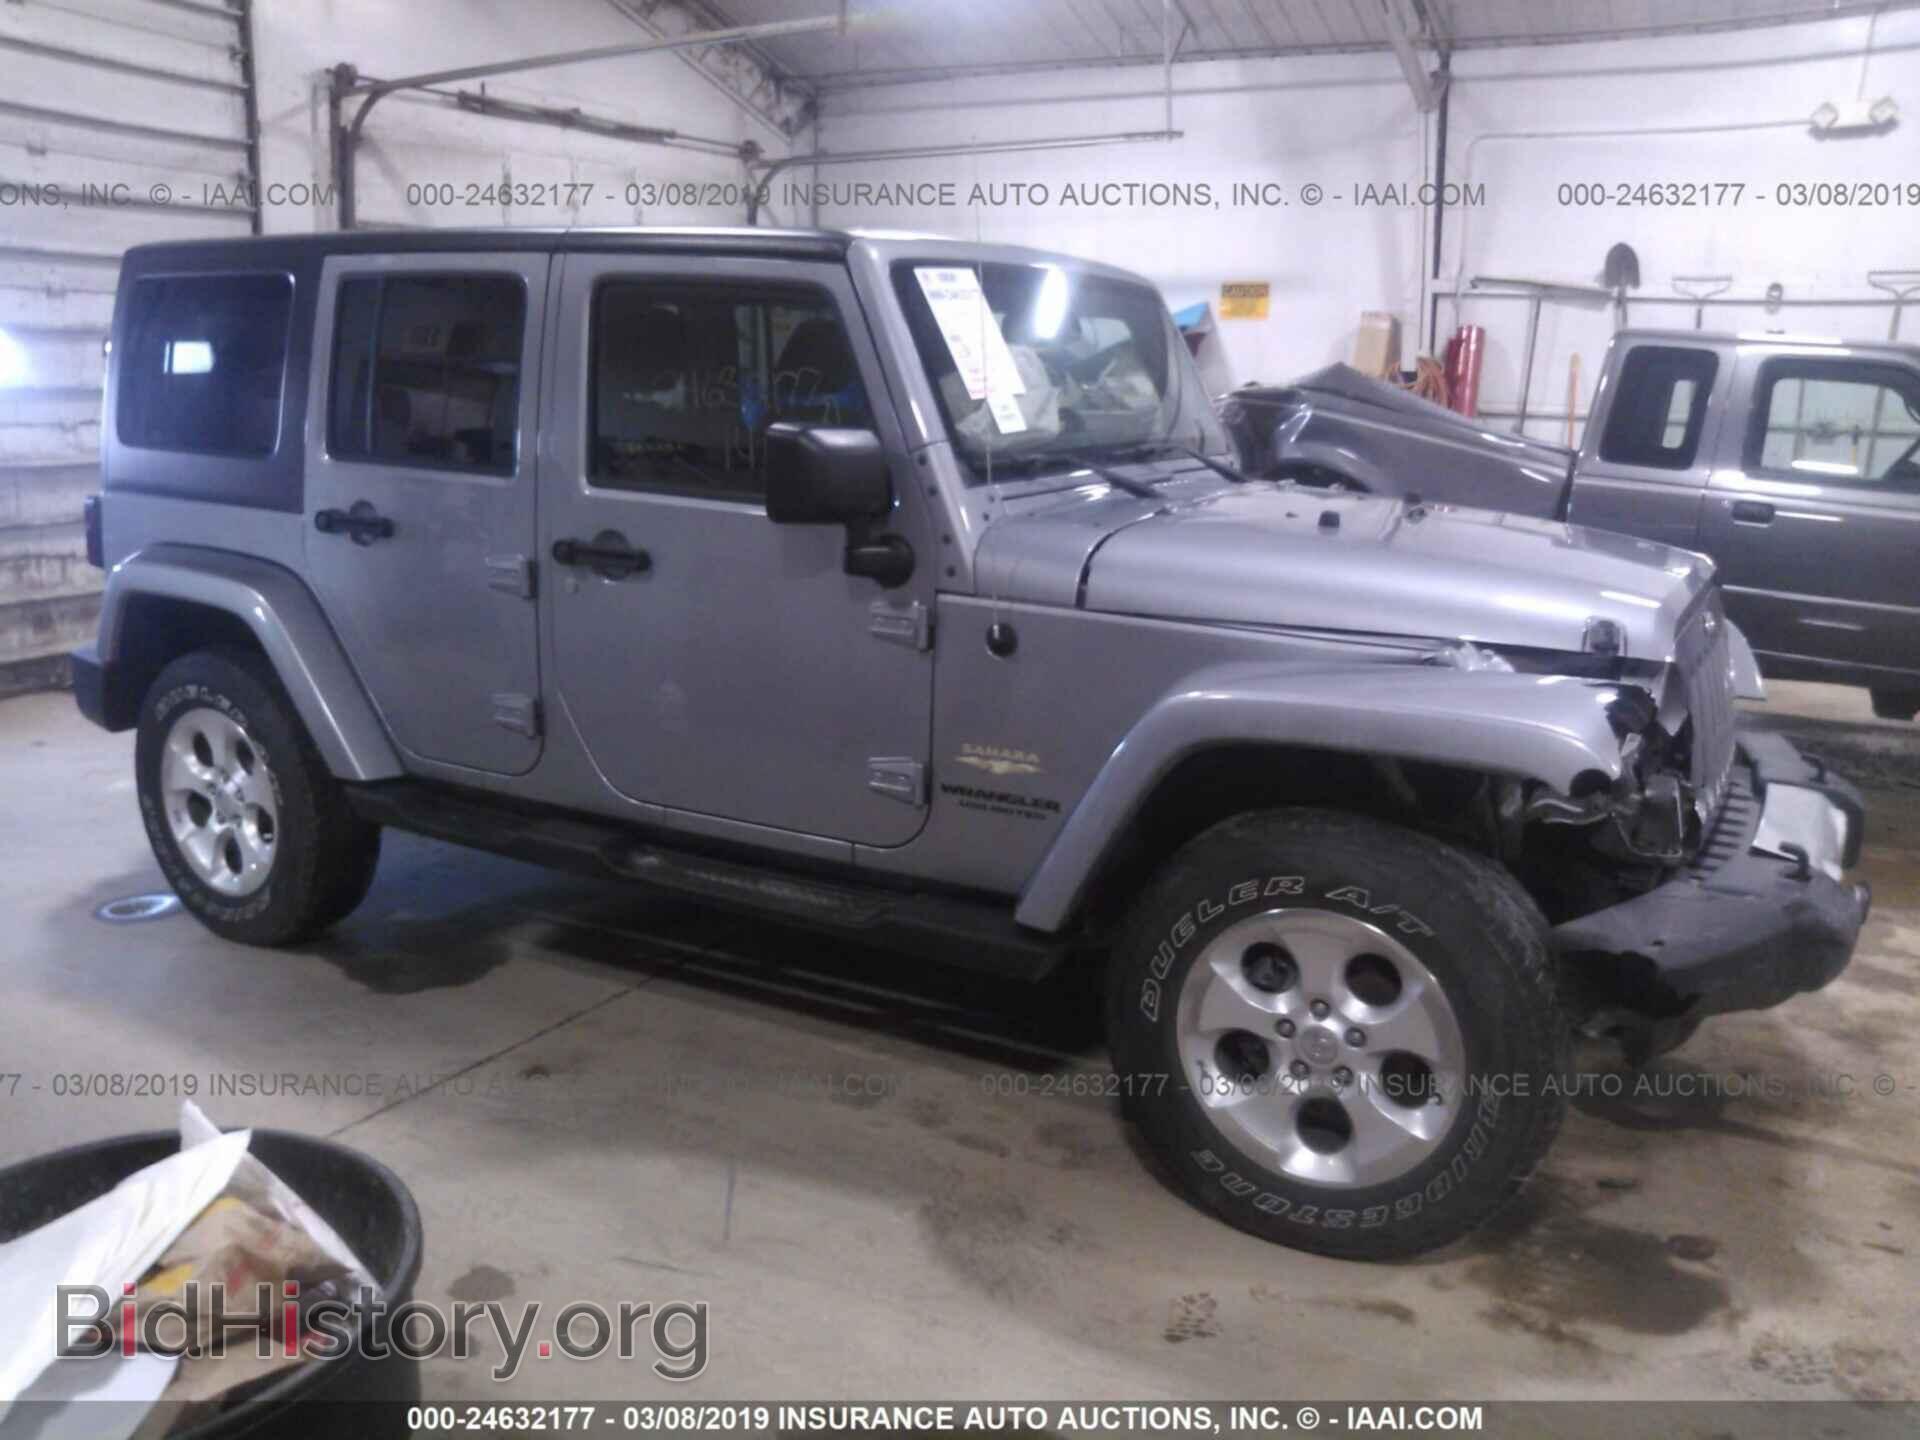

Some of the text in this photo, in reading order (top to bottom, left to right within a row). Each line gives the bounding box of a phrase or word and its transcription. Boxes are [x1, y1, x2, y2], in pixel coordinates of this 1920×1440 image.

[960, 743, 1041, 763] SAHARA
[1140, 876, 1437, 1022] DUELER A/T
